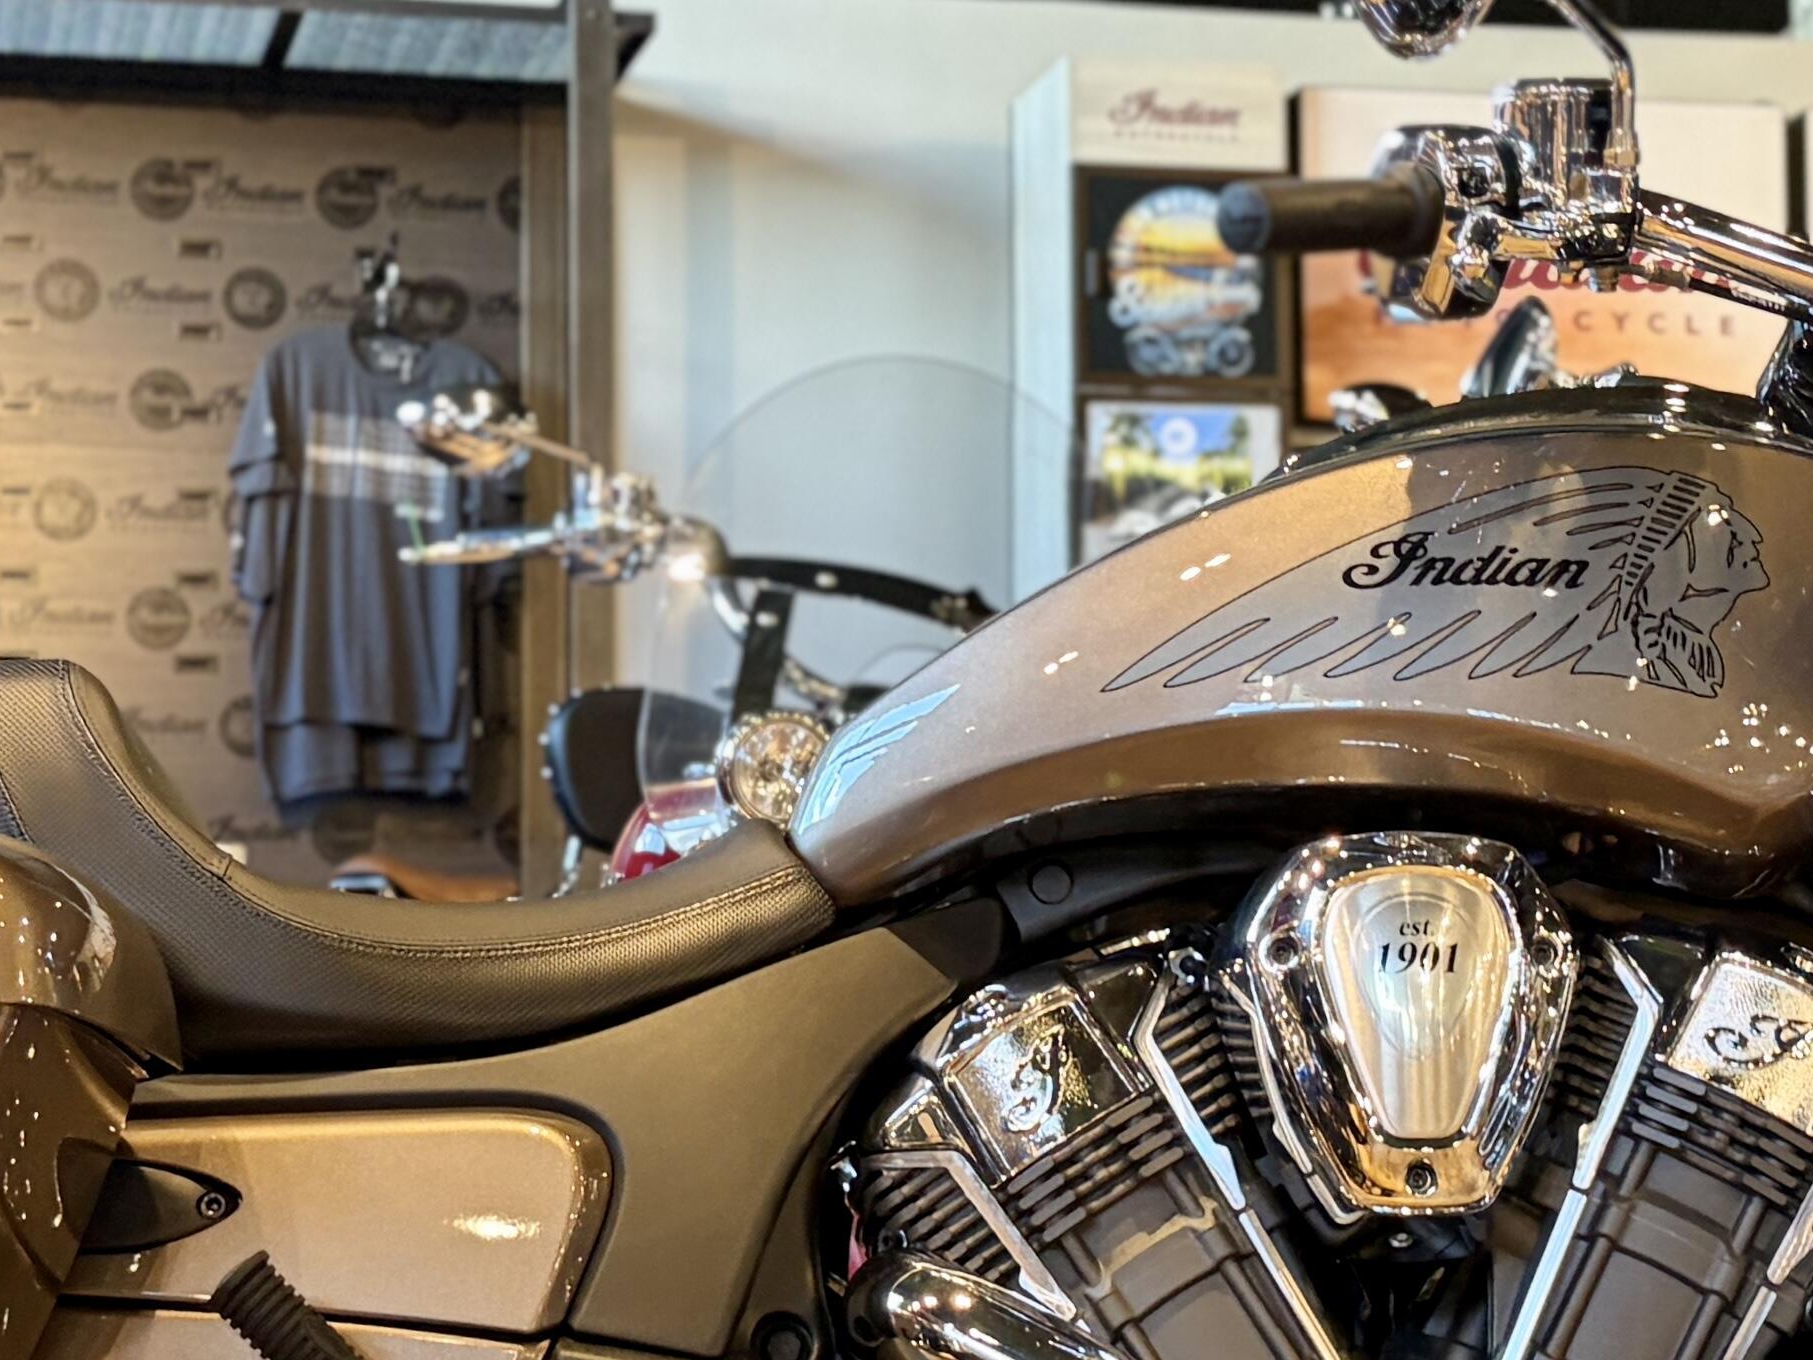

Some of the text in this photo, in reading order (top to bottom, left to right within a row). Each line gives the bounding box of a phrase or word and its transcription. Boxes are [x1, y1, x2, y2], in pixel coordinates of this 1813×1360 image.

[1109, 90, 1243, 127] Indian
[199, 174, 304, 204] Indian
[391, 183, 487, 212] Indian
[107, 276, 213, 305] Indian
[1342, 531, 1590, 589] Indian
[1399, 919, 1435, 937] est.
[1377, 941, 1459, 974] 1901
